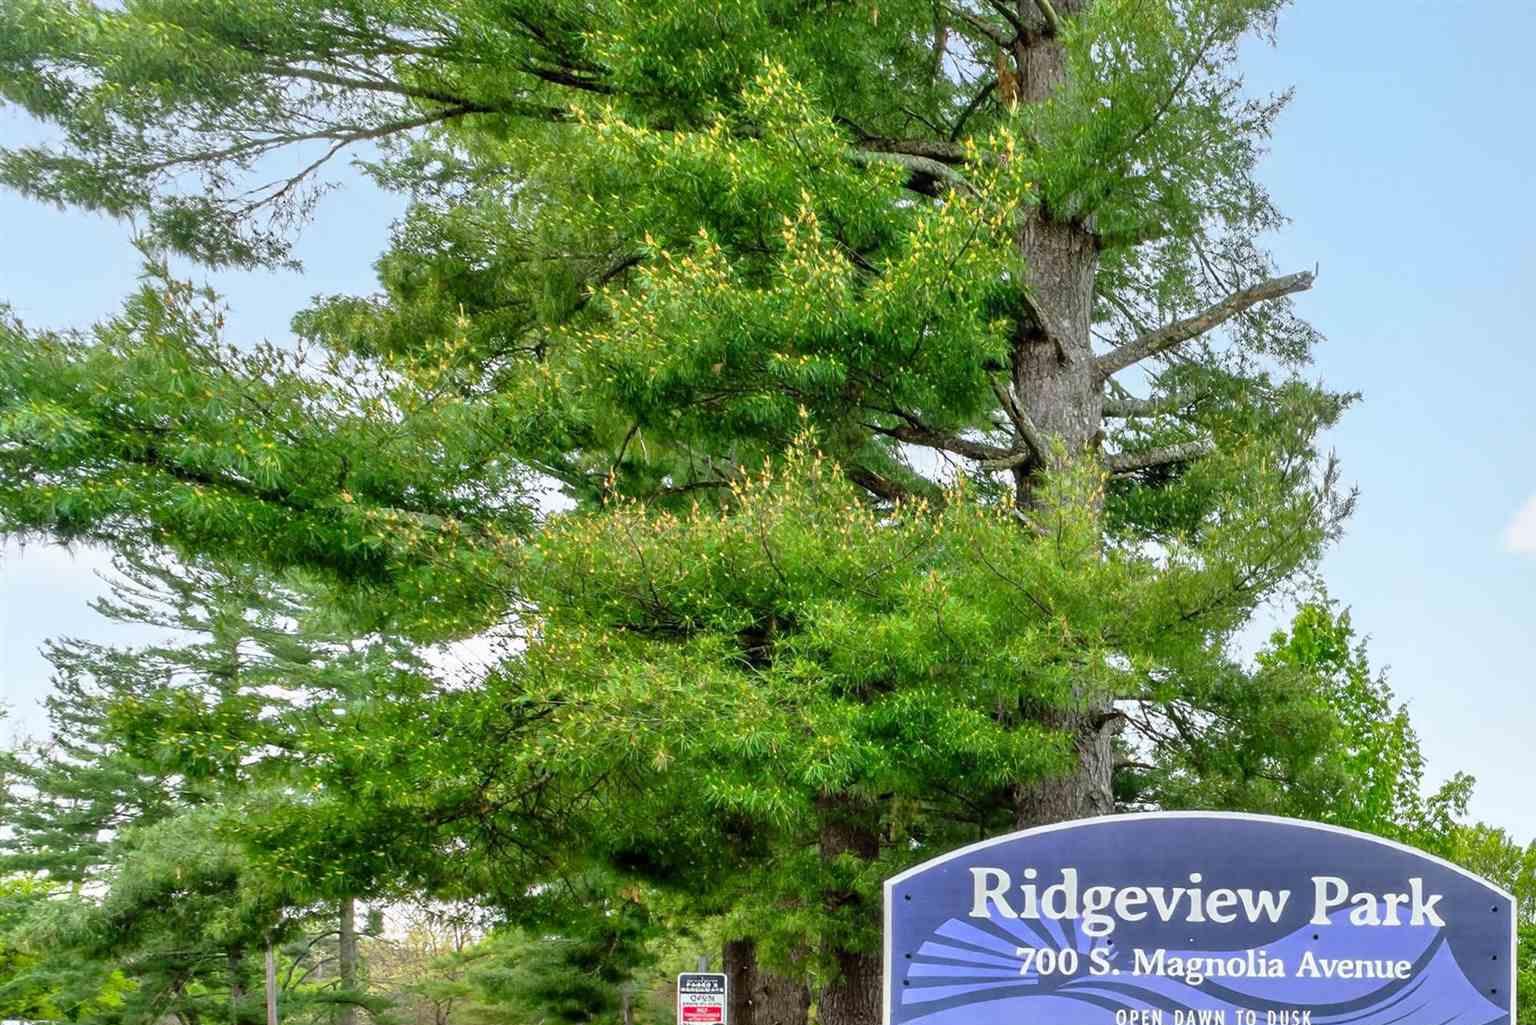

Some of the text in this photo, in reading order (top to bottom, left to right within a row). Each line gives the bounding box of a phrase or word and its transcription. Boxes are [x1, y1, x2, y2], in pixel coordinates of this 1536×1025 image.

[968, 867, 1446, 938] Ridgeview Park
[1015, 946, 1412, 986] 700 S. Magnolia Avenue
